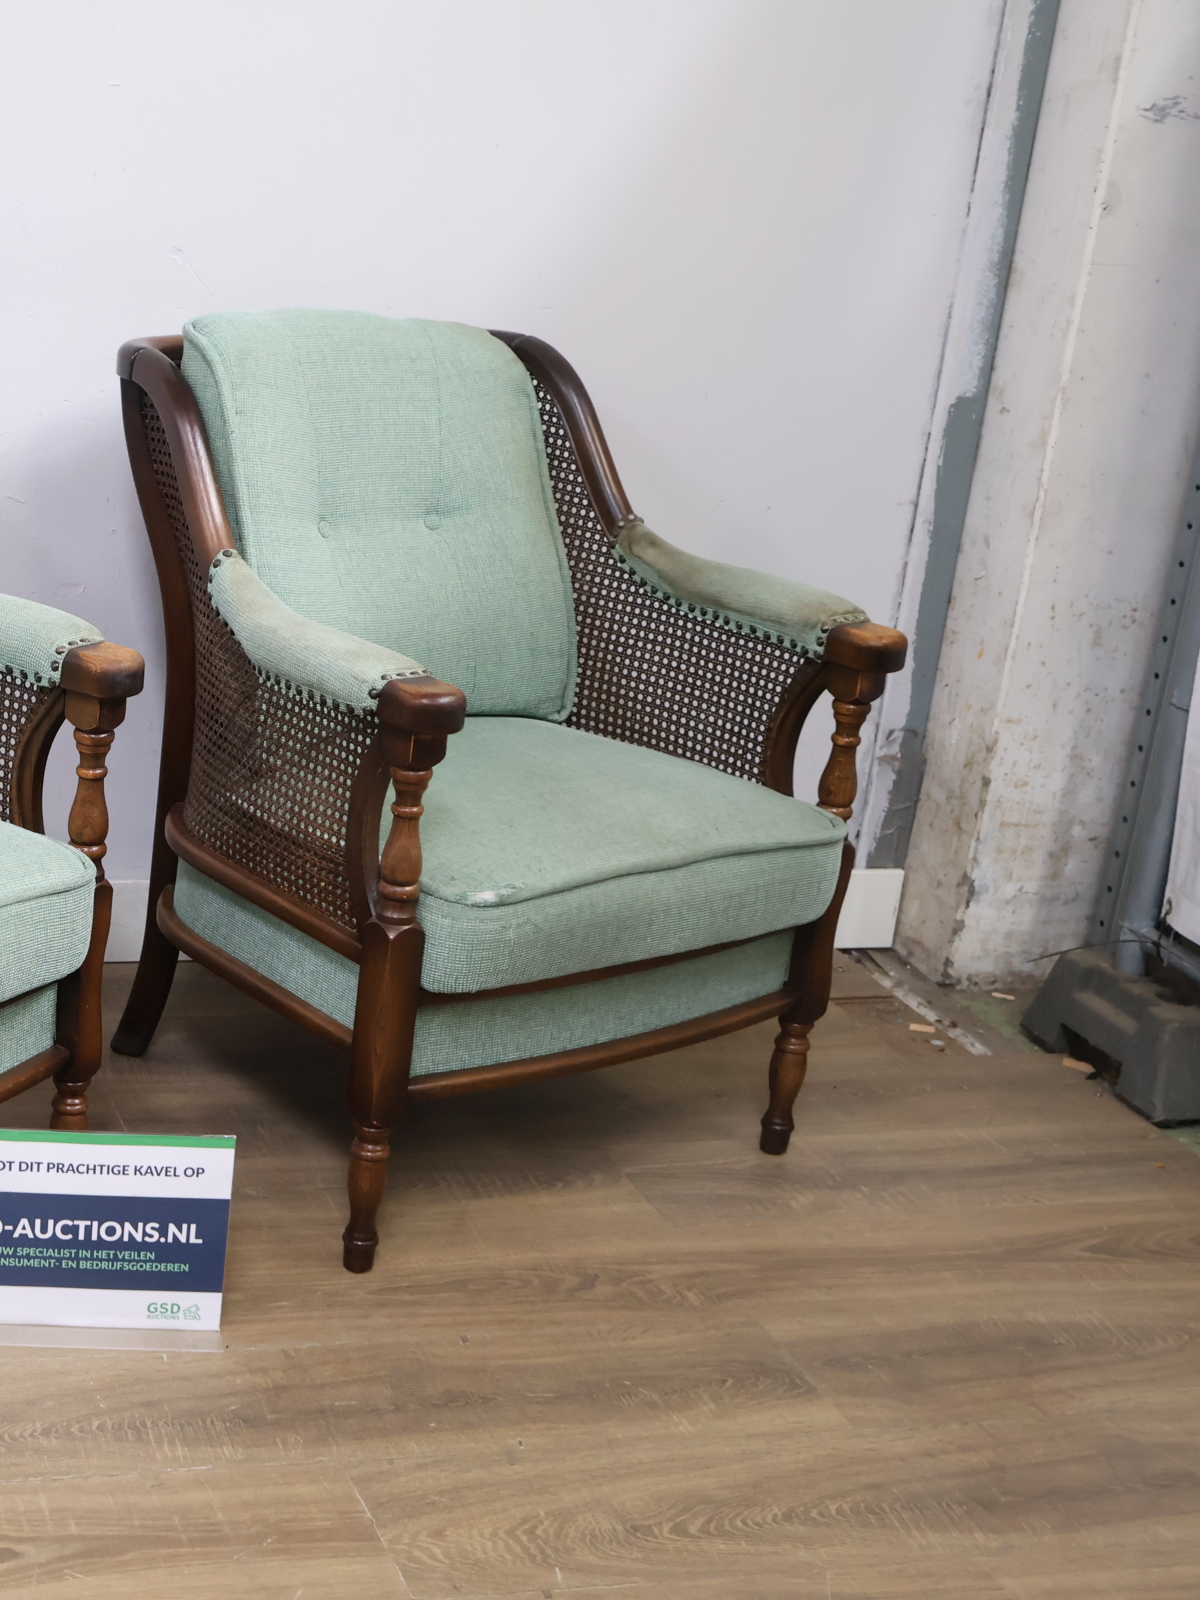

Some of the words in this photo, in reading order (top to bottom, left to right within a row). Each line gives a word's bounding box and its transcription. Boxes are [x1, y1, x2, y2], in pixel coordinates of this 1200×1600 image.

[18, 1161, 44, 1173] DIT
[46, 1162, 130, 1176] PRACHTIGE
[134, 1165, 180, 1177] KAVEL
[183, 1166, 205, 1179] OP
[16, 1247, 77, 1258] SPECIALIST
[79, 1249, 91, 1259] IN
[93, 1249, 116, 1260] HET
[117, 1250, 155, 1260] VEILEN
[61, 1259, 77, 1269] EN
[79, 1260, 189, 1272] BEDRIJFSGOEDEREN
[146, 1302, 181, 1315] GSD
